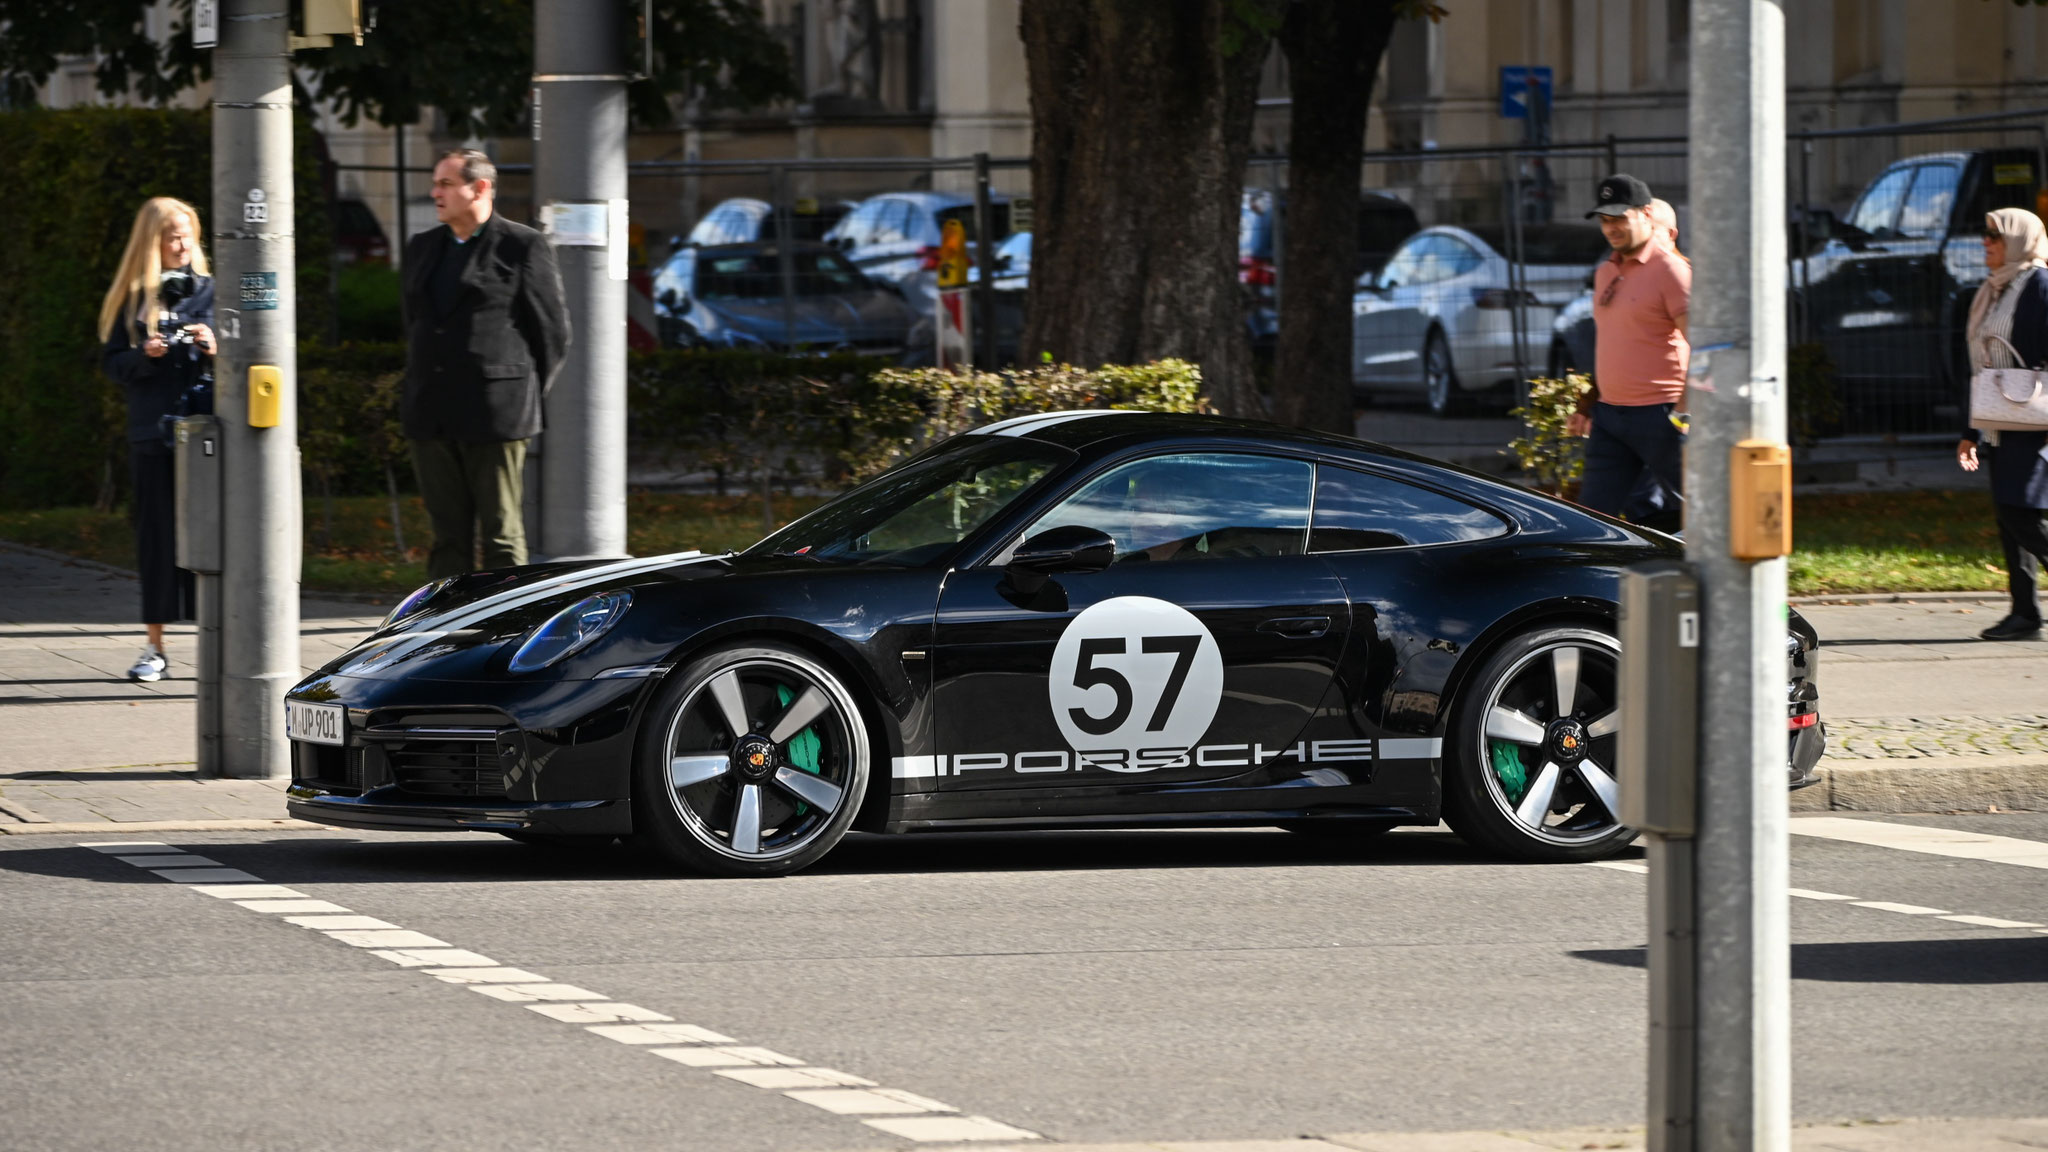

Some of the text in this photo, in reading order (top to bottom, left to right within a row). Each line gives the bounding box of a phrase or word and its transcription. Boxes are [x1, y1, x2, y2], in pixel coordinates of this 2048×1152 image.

[1068, 635, 1202, 735] 57
[316, 709, 337, 739] 901
[953, 739, 1372, 776] PORSCHE
